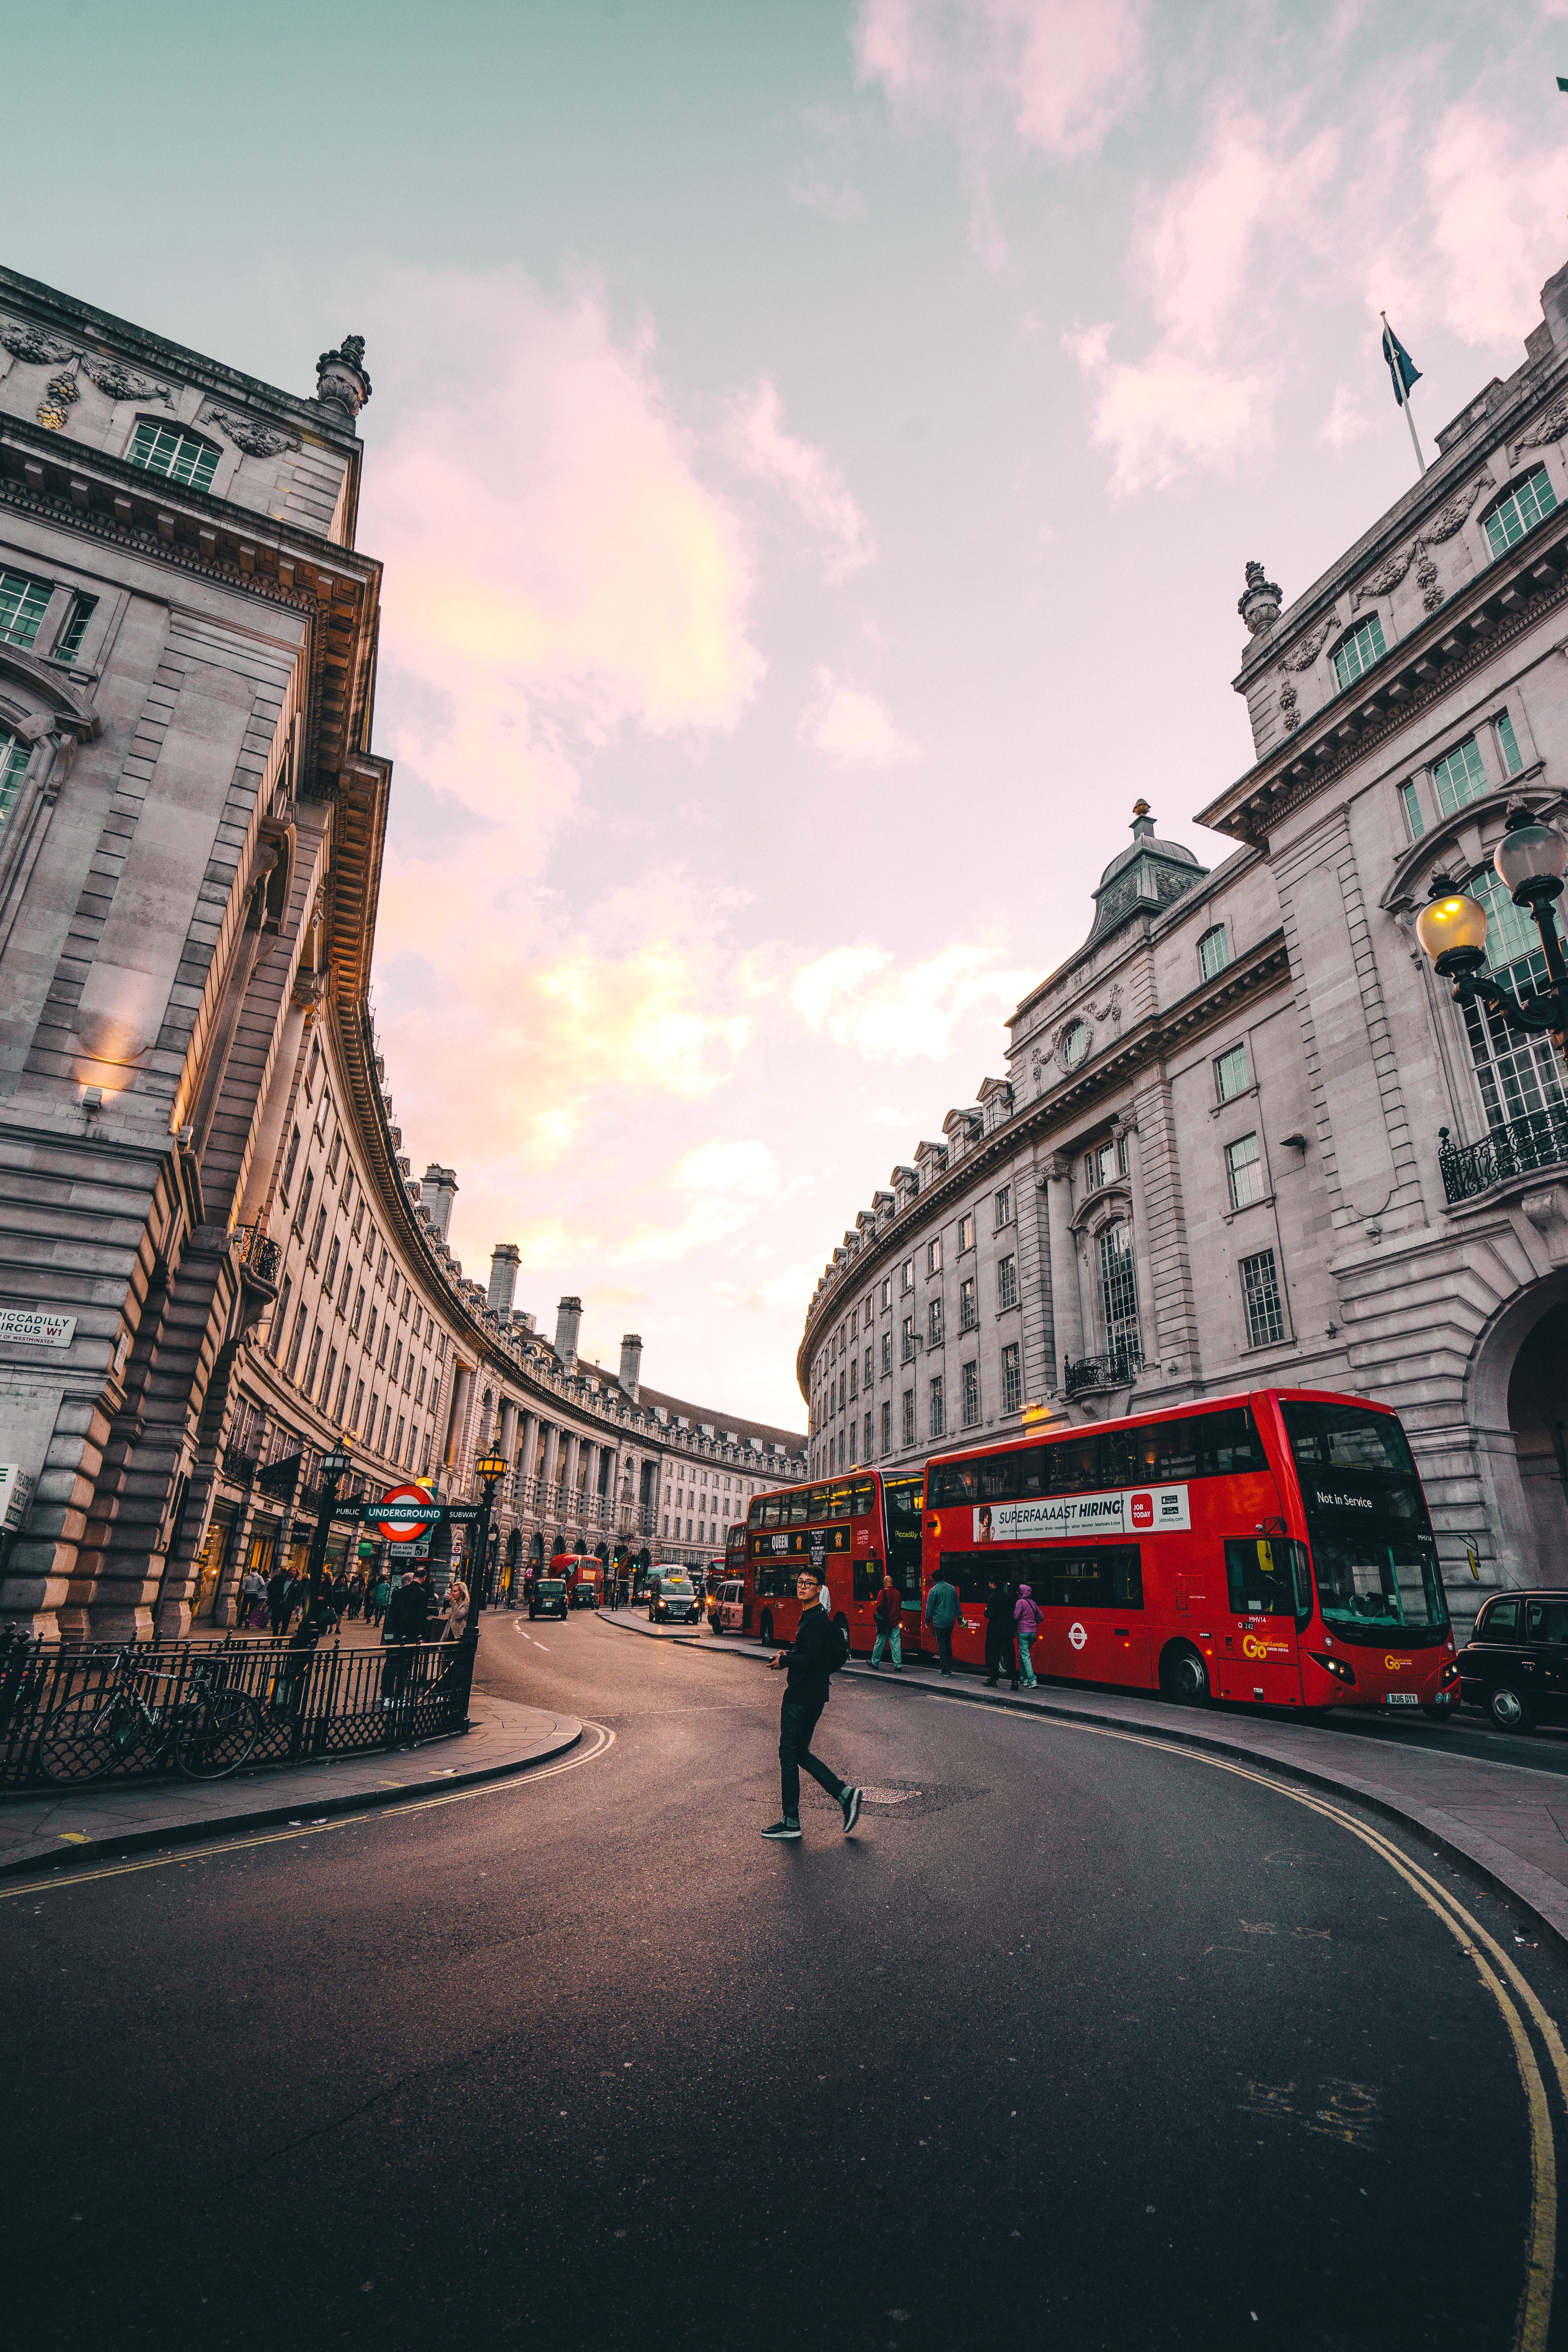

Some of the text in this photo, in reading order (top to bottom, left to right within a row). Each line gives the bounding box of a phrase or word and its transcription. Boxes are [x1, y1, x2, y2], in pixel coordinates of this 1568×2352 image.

[0, 1322, 62, 1336] IRCUS W1
[13, 1336, 54, 1344] WESTMINSTER
[15, 1470, 32, 1491] THEATRE
[11, 1488, 27, 1507] TICKETS
[1317, 1491, 1372, 1508] Not in Service
[368, 1508, 440, 1518] UNDERGROUND
[999, 1499, 1124, 1524] SUPERFAAAAST HIRING!
[772, 1534, 788, 1550] QUEEN
[895, 1531, 918, 1539] Piccadilly
[1243, 1635, 1267, 1659] Go
[1385, 1655, 1400, 1670] Go
[1391, 1695, 1416, 1703] BU16 OYY
